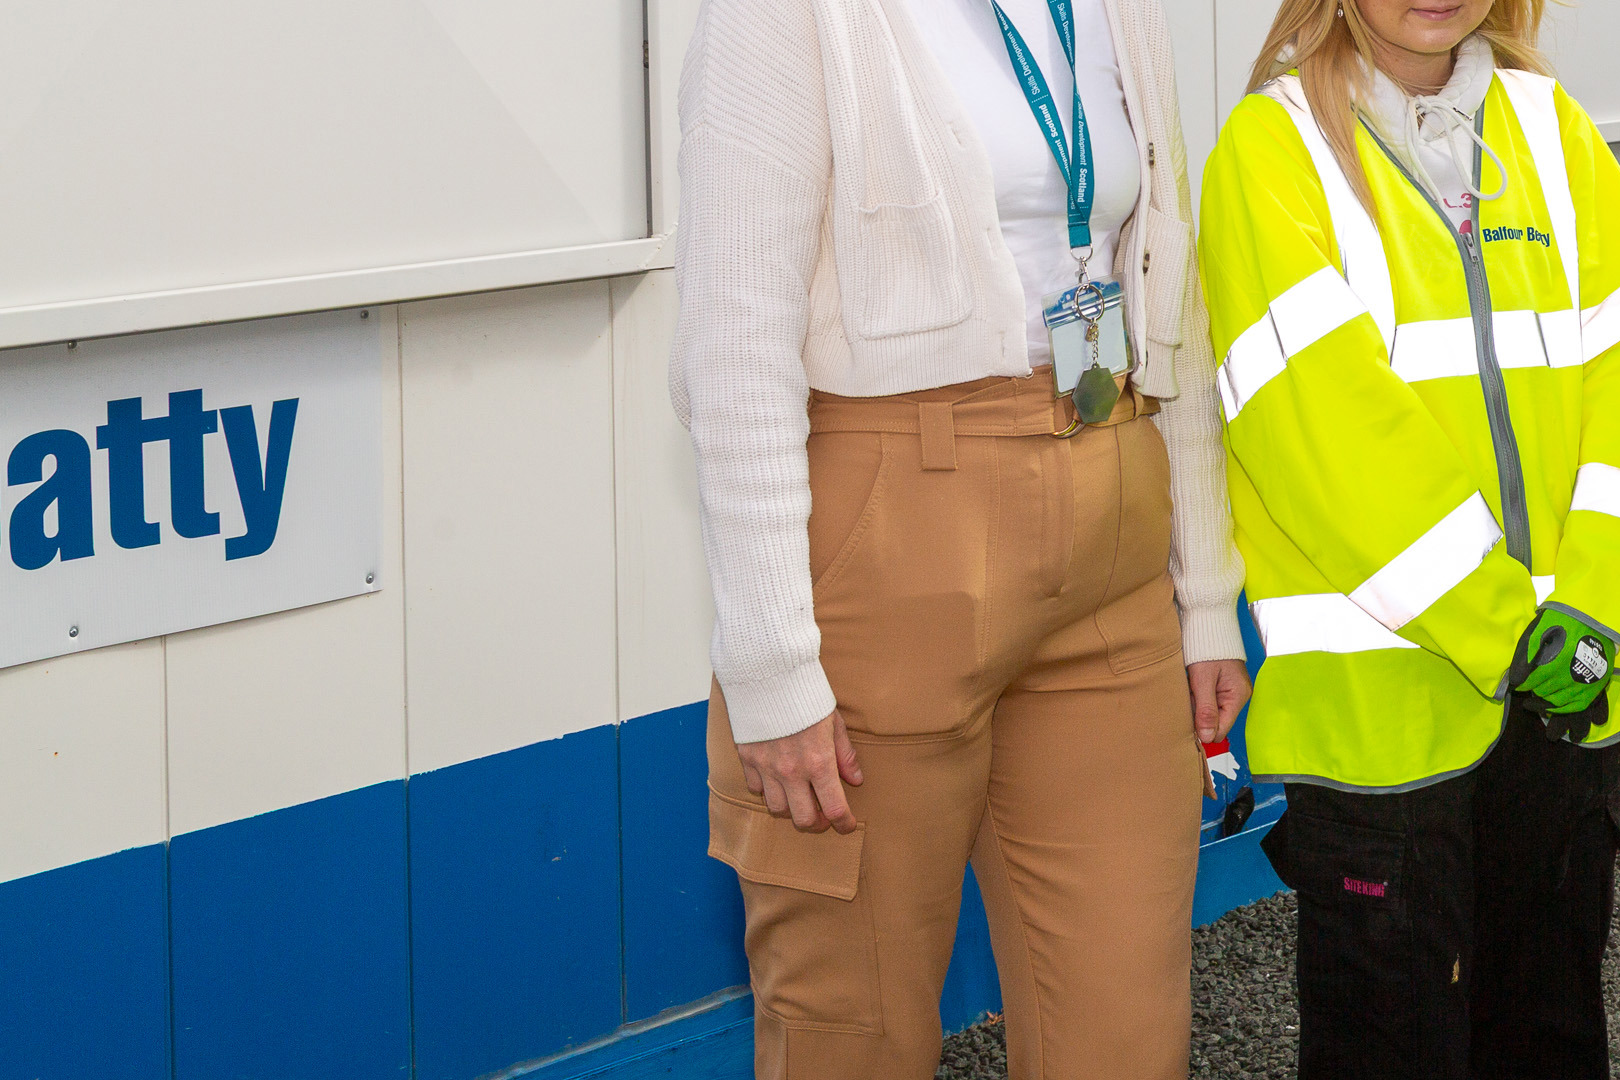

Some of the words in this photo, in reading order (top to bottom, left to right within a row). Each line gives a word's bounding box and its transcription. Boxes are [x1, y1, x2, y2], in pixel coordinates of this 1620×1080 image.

[1057, 3, 1067, 21] Skills
[1028, 76, 1041, 96] Skills
[1039, 103, 1059, 138] Scotland
[1077, 120, 1088, 166] Development
[1077, 168, 1088, 203] Scotland
[1482, 226, 1523, 243] Balfour
